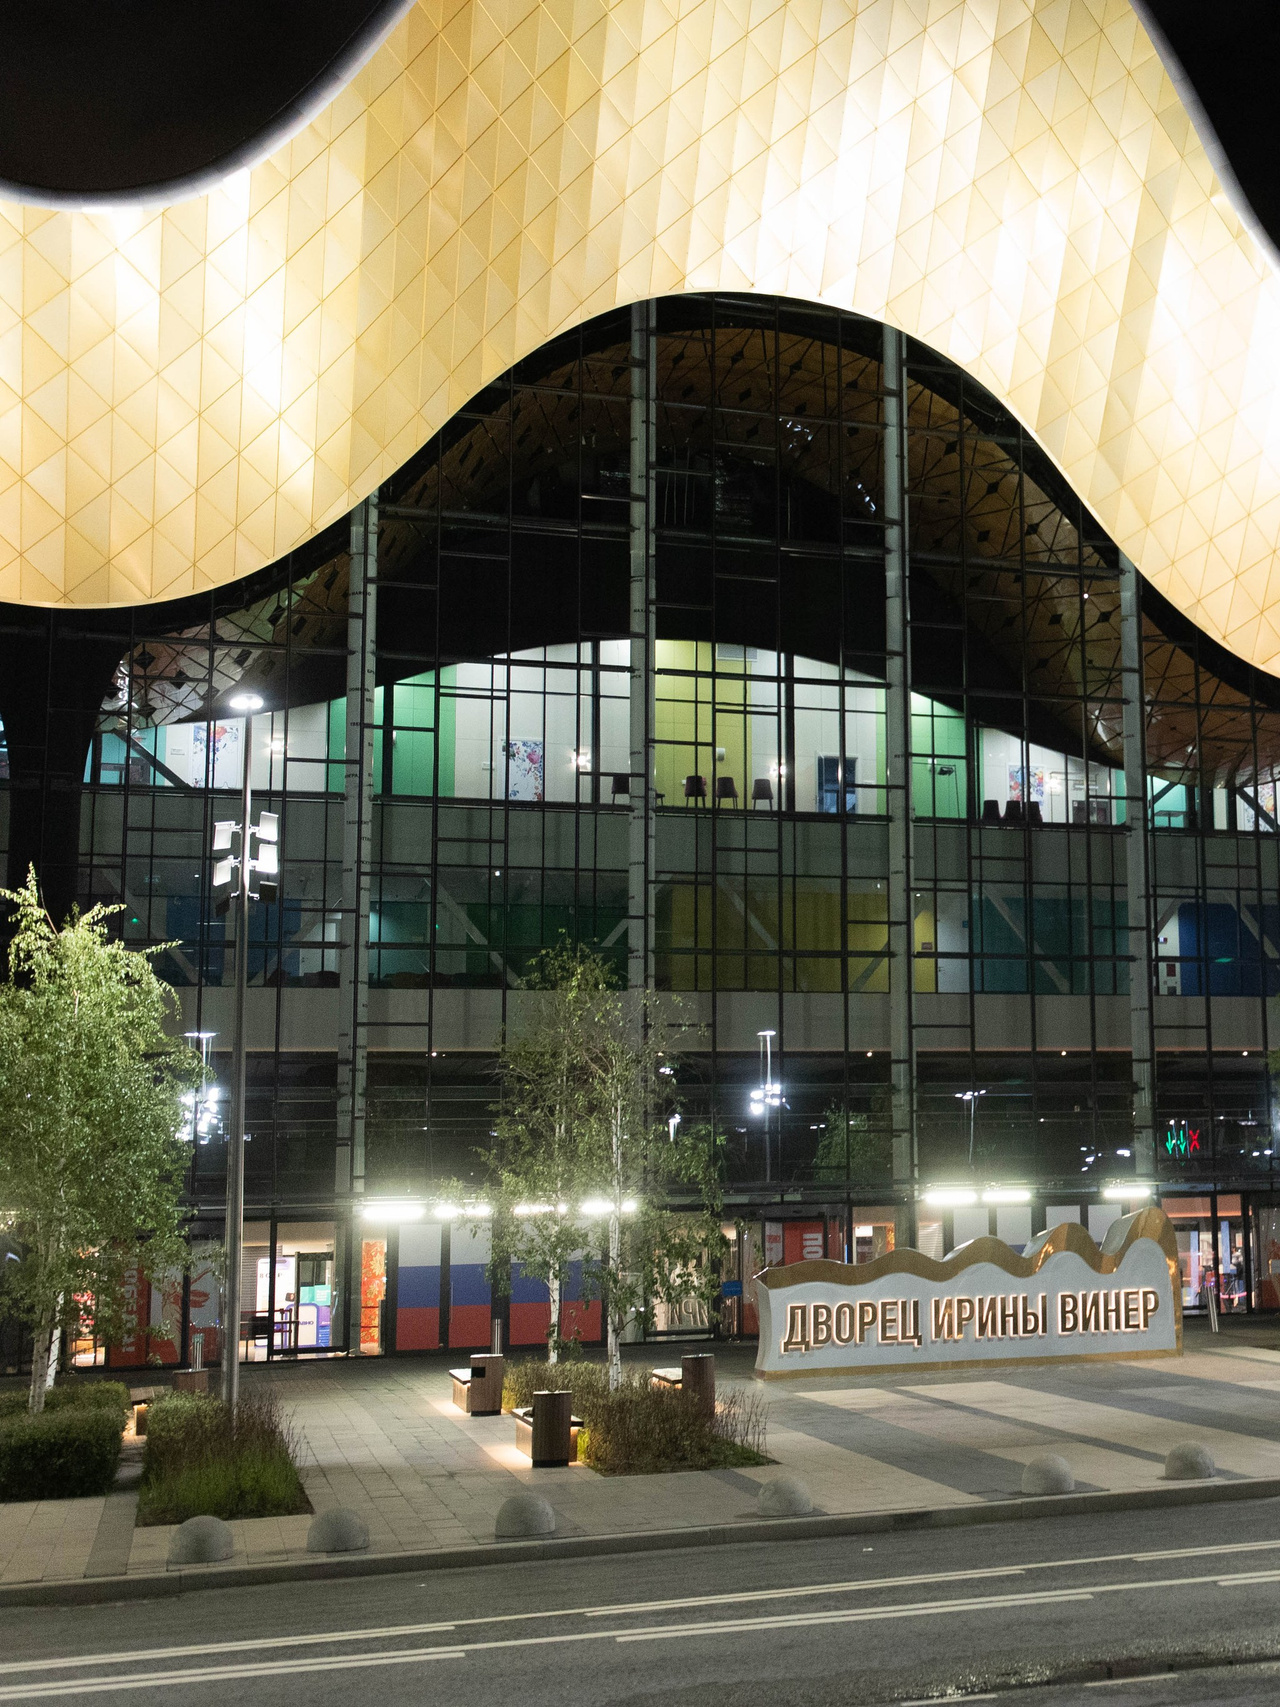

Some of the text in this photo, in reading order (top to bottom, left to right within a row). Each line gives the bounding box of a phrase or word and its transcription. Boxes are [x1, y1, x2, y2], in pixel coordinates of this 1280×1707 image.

[780, 1286, 1160, 1354] ДВОРЕЦ ИРИНЫ ВИНЕР
